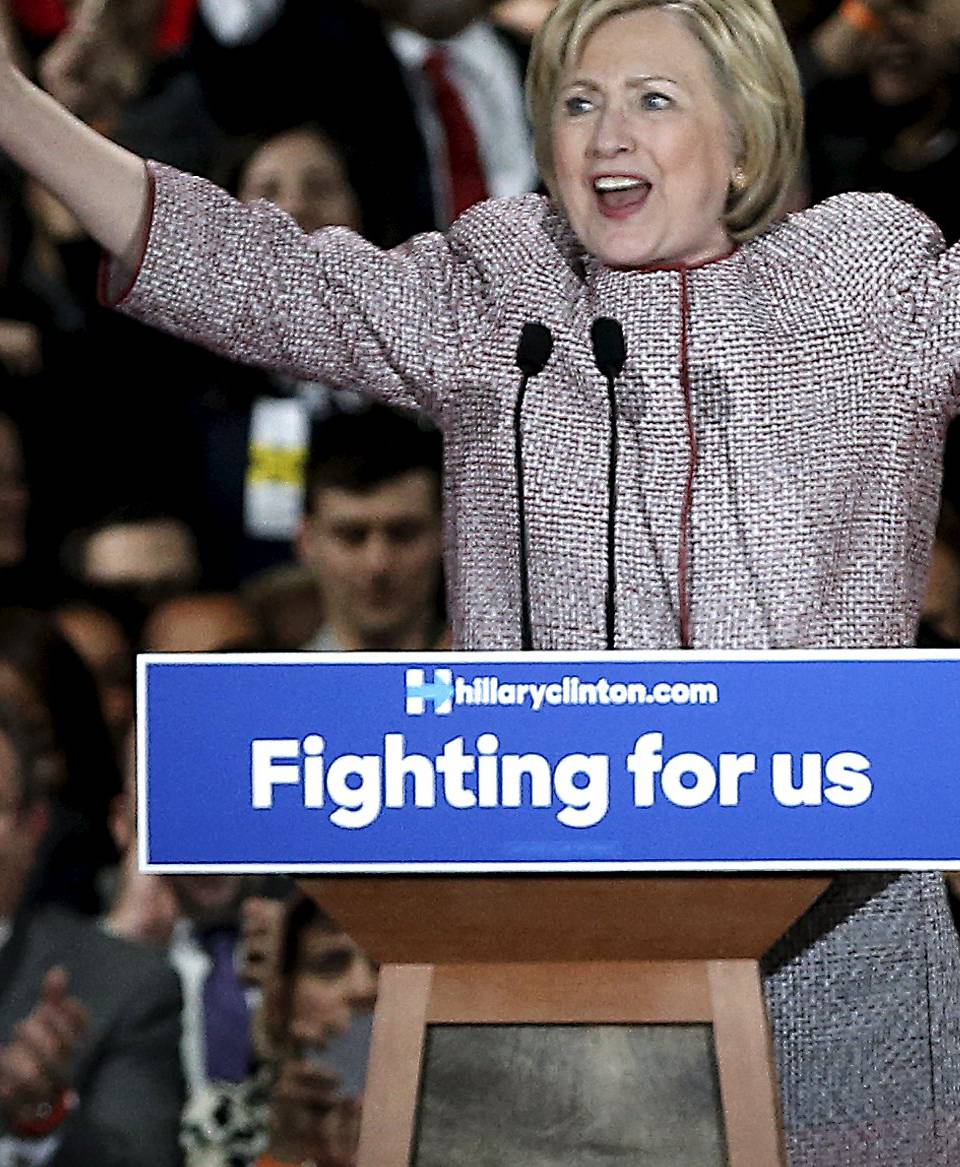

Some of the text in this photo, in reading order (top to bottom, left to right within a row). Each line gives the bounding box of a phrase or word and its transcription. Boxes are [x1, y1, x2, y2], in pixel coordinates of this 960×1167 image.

[455, 676, 719, 712] hillaryclinton.com
[250, 731, 873, 829] Fighting for us
